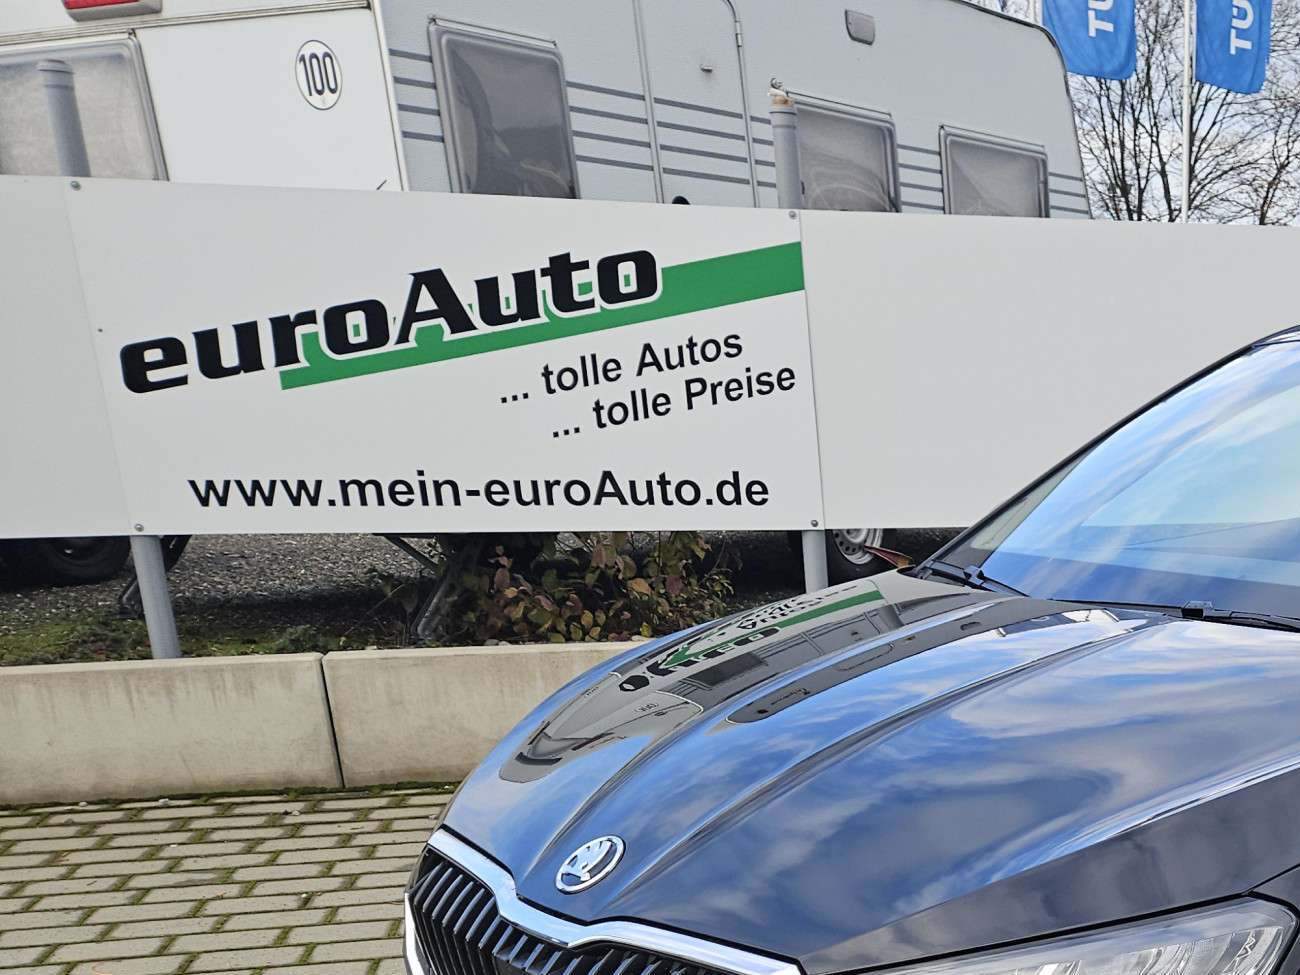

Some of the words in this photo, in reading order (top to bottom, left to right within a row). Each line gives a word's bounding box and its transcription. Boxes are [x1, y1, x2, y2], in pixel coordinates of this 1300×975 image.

[299, 51, 338, 96] 100
[121, 250, 658, 394] euroAuto
[541, 353, 622, 395] tolle
[635, 334, 743, 377] Autos
[592, 387, 672, 429] tolle
[684, 367, 796, 411] Preise
[188, 469, 769, 507] www.mein-euroAuto.de
